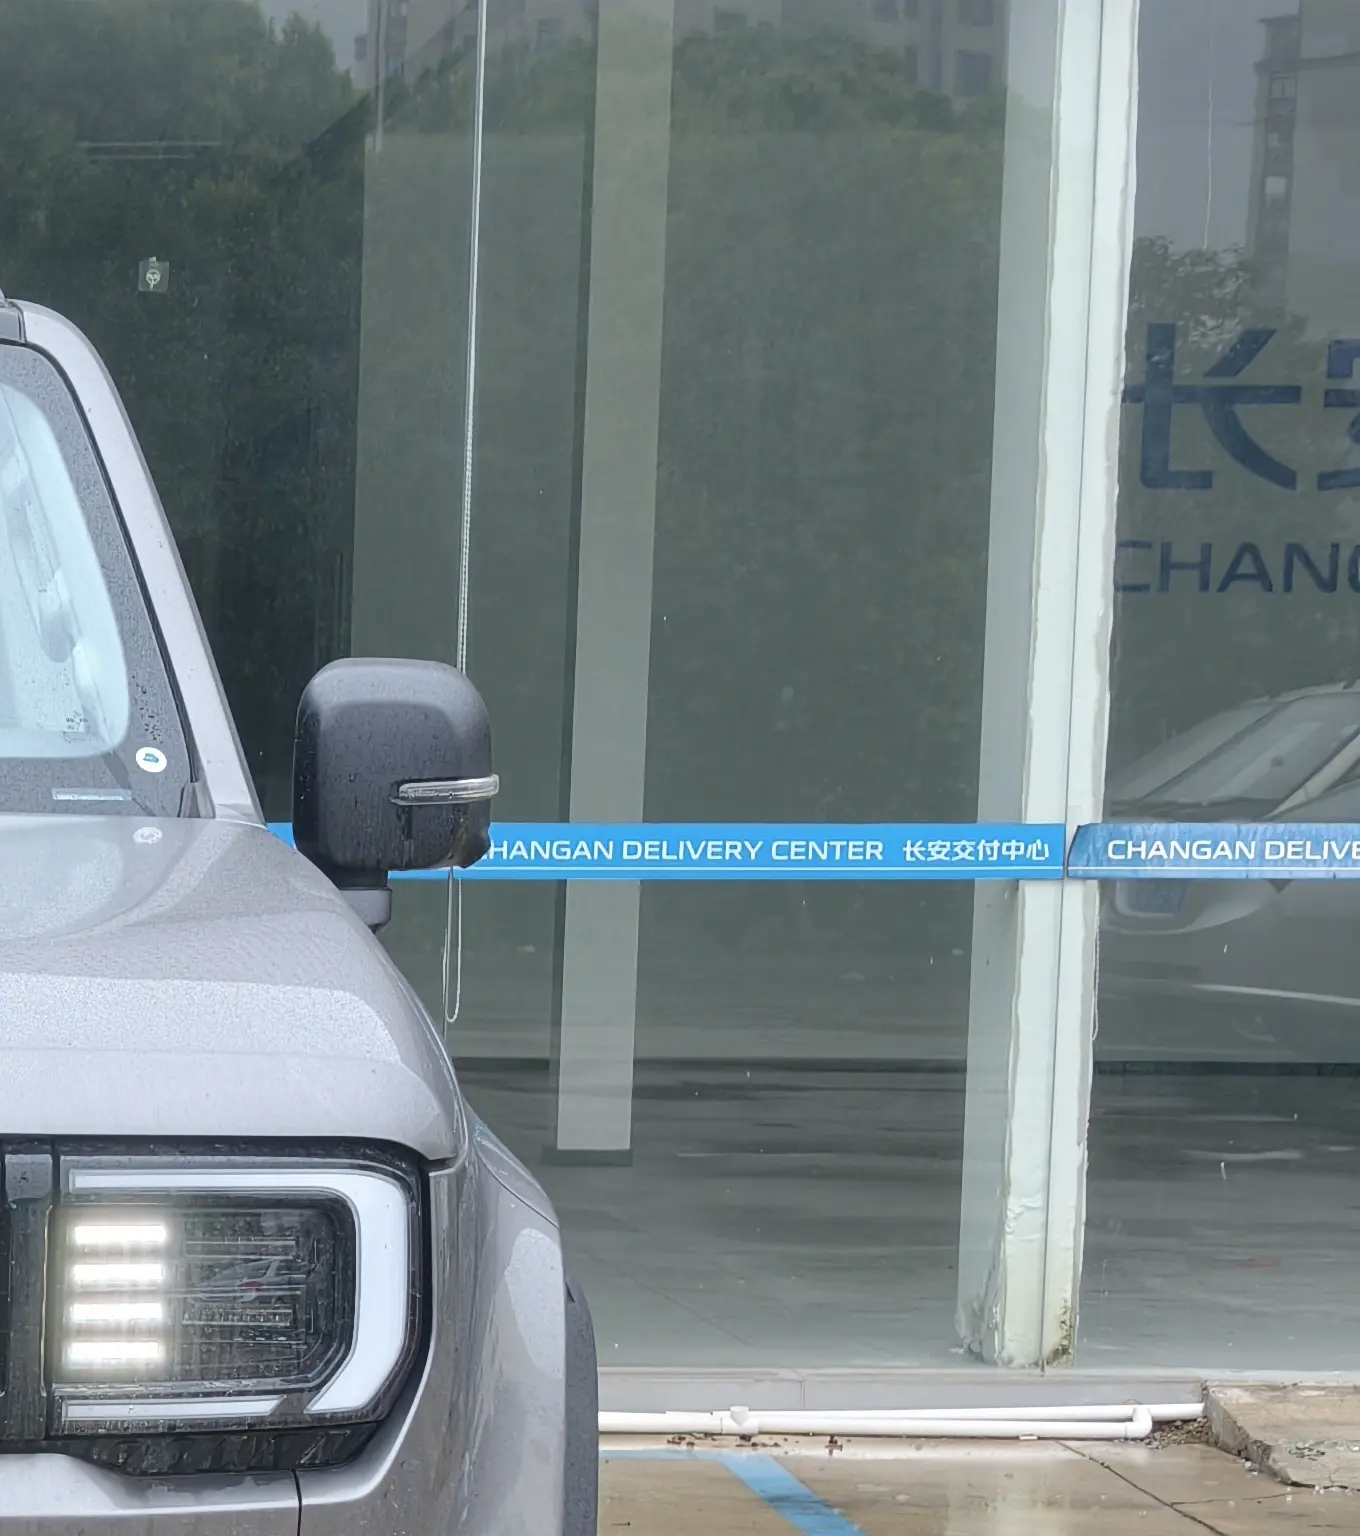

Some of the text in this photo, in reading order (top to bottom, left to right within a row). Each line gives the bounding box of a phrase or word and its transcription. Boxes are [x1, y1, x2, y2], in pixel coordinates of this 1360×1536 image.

[1120, 322, 1360, 492] 长
[1114, 541, 1360, 593] CHAN
[481, 839, 1050, 862] HANGAN DELIVERY CENTER 长安交付中心
[1107, 839, 1257, 861] CHANGAN
